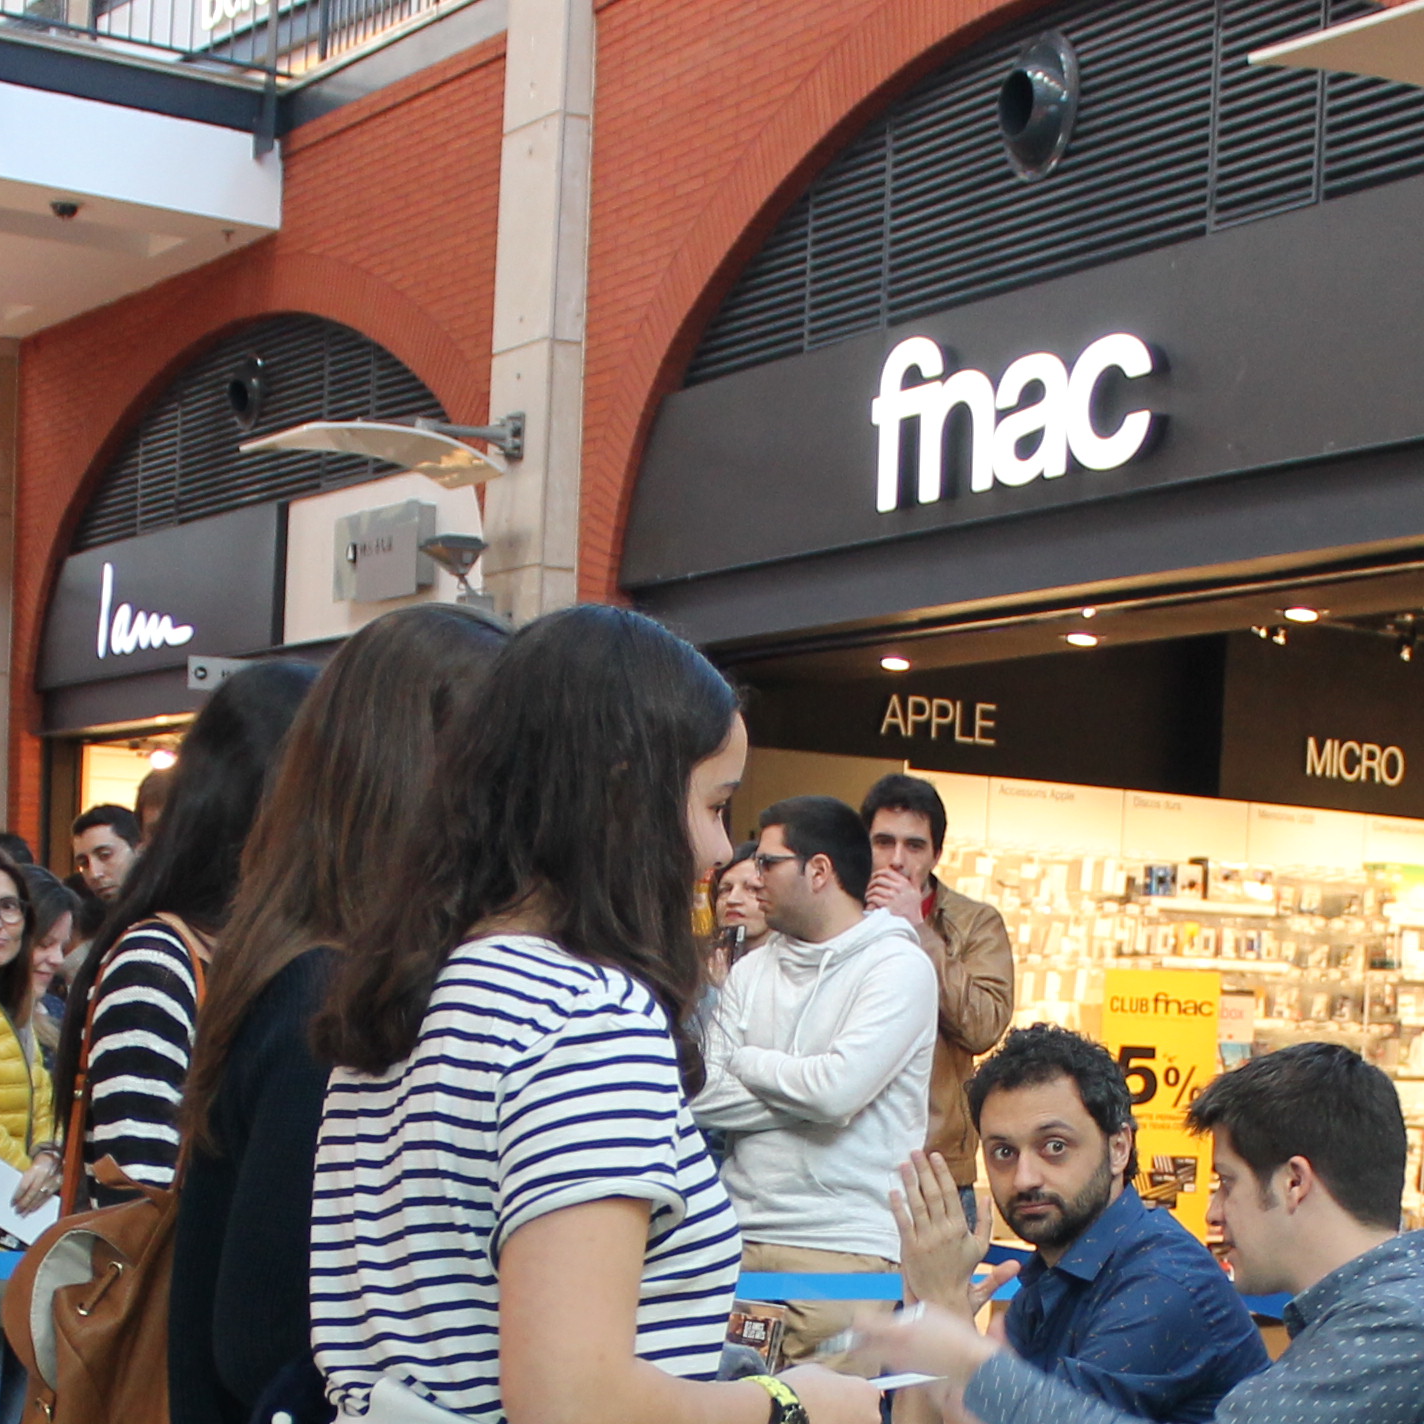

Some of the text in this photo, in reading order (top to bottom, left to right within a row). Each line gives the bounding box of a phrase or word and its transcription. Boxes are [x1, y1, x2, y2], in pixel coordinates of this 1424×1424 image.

[871, 332, 1153, 513] fnac
[880, 695, 997, 747] APPLE
[1305, 735, 1404, 787] MICRO
[1110, 992, 1214, 1018] CLUB fnac
